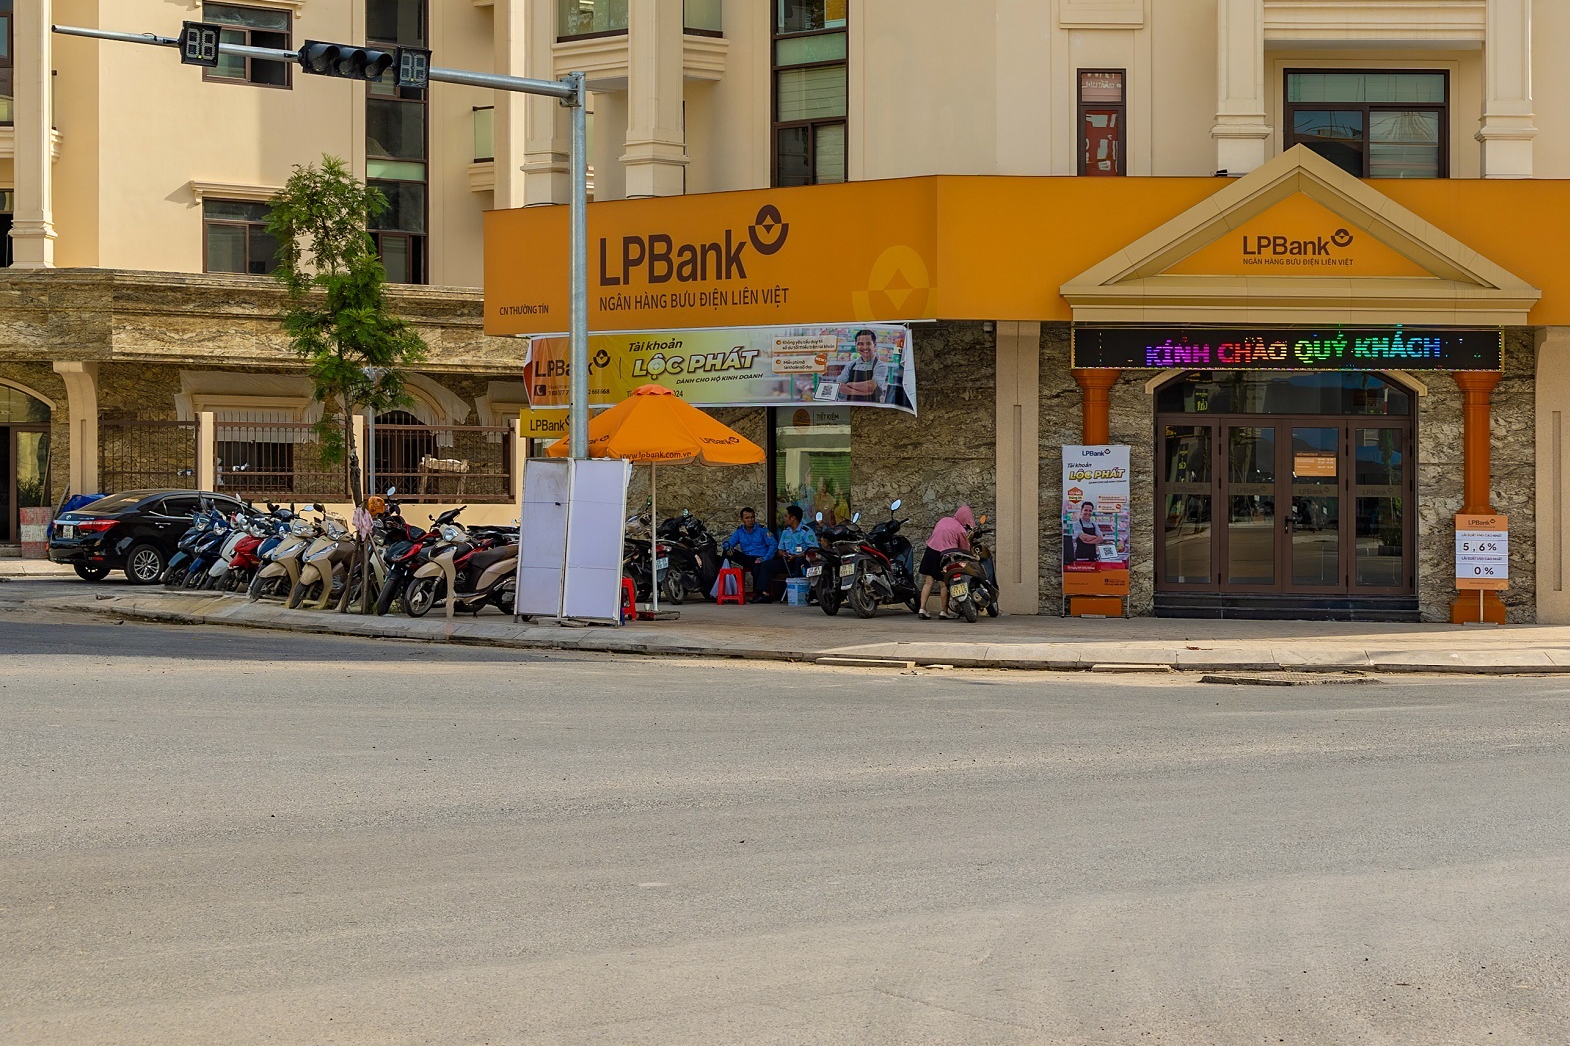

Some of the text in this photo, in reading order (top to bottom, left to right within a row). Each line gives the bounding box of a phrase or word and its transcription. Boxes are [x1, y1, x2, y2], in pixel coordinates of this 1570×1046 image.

[1243, 235, 1330, 256] LPBank
[600, 229, 747, 287] LPBank
[1264, 257, 1284, 265] HÀNG
[1303, 257, 1320, 267] ĐIỆN
[1321, 257, 1337, 266] LIÊN
[1338, 257, 1354, 267] VIỆT
[600, 285, 790, 312] NGÂN HÀNG BƯU ĐIỆN LIÊN VIỆT
[500, 303, 549, 315] CN THƯỜNG TÍN
[628, 338, 683, 352] Tài khoản
[1146, 330, 1441, 366] KÍNH CHÀO QUÝ KHÁCH
[534, 359, 594, 378] LPBak
[632, 346, 760, 380] LỘC PHÁT
[710, 375, 721, 383] HỘ
[530, 419, 565, 432] LPBank
[1069, 467, 1126, 482] LỘC PHÁT
